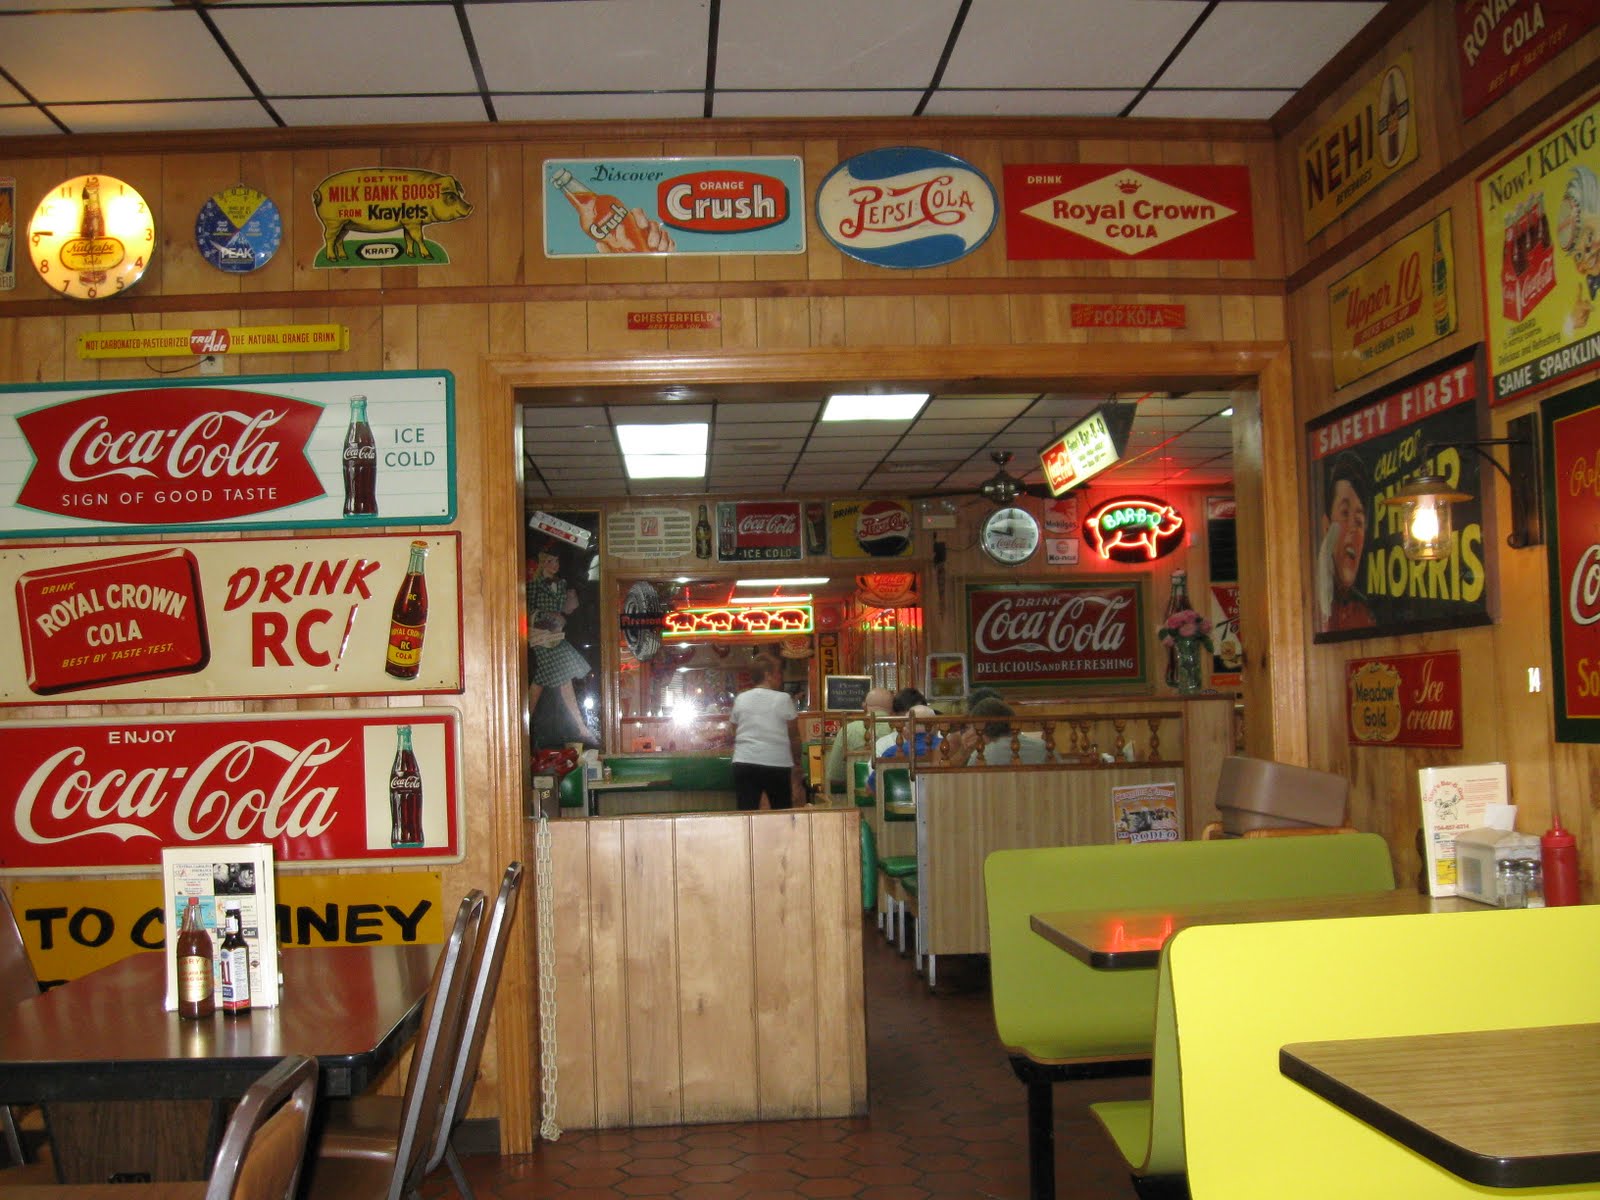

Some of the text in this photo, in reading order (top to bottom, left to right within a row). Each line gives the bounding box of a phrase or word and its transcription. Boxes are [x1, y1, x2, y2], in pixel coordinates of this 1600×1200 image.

[1502, 2, 1545, 55] COLA
[1537, 113, 1597, 179] KING
[1305, 105, 1374, 210] NEHI
[363, 175, 384, 183] GET
[590, 163, 663, 181] Discover
[1027, 175, 1062, 184] DRINK
[329, 183, 442, 203] MILK BANK BOOST
[700, 181, 745, 191] ORANGE
[666, 183, 776, 222] Crush
[338, 203, 428, 222] FROM Kraylets
[1053, 200, 1215, 225] Royal Crown
[590, 203, 628, 241] Crush
[146, 228, 152, 241] 3
[1106, 225, 1158, 238] COLA
[221, 248, 252, 258] PEAK
[365, 247, 395, 256] KRAFT
[40, 259, 49, 274] 8
[135, 256, 143, 268] 4
[63, 280, 70, 292] 7
[88, 287, 96, 298] 6
[116, 277, 125, 290] 5
[633, 313, 714, 322] CHESTERFIELD
[1094, 310, 1123, 325] POP
[1127, 310, 1163, 325] KOLA
[85, 341, 98, 350] NOT
[232, 335, 245, 345] THE
[248, 334, 279, 345] NATURAL
[282, 333, 309, 343] ORANGE
[313, 332, 336, 342] DRINK
[1498, 365, 1532, 397] SAME
[1319, 368, 1468, 453] SAFETY FIRST
[59, 407, 290, 482] Coca-Cola
[394, 428, 425, 444] ICE
[385, 451, 436, 468] COLD
[1374, 450, 1398, 482] CALL
[62, 487, 278, 507] SIGN OF GOOD TASTE
[833, 505, 860, 519] DRINK
[738, 513, 798, 535] Coca-Cola
[743, 549, 792, 558] ICE COLD
[1367, 523, 1485, 602] MORRIS
[41, 582, 76, 595] DRINK
[223, 558, 381, 612] DRINK
[36, 584, 187, 638] ROYAL CROWN
[1016, 597, 1062, 607] DRINK
[86, 619, 143, 647] COLA
[975, 595, 1132, 654] Coca-Cola
[401, 641, 410, 650] RC
[62, 655, 90, 668] BEST
[93, 652, 107, 663] BY
[977, 657, 1134, 673] DELICIOUS AND REFRESHING
[1415, 659, 1444, 703] Ice
[1355, 682, 1395, 702] Meadow
[1364, 706, 1387, 727] Gold
[1407, 709, 1455, 731] cream
[108, 729, 176, 745] ENJOY
[14, 737, 353, 845] Coca-Cola
[25, 907, 115, 950] TO
